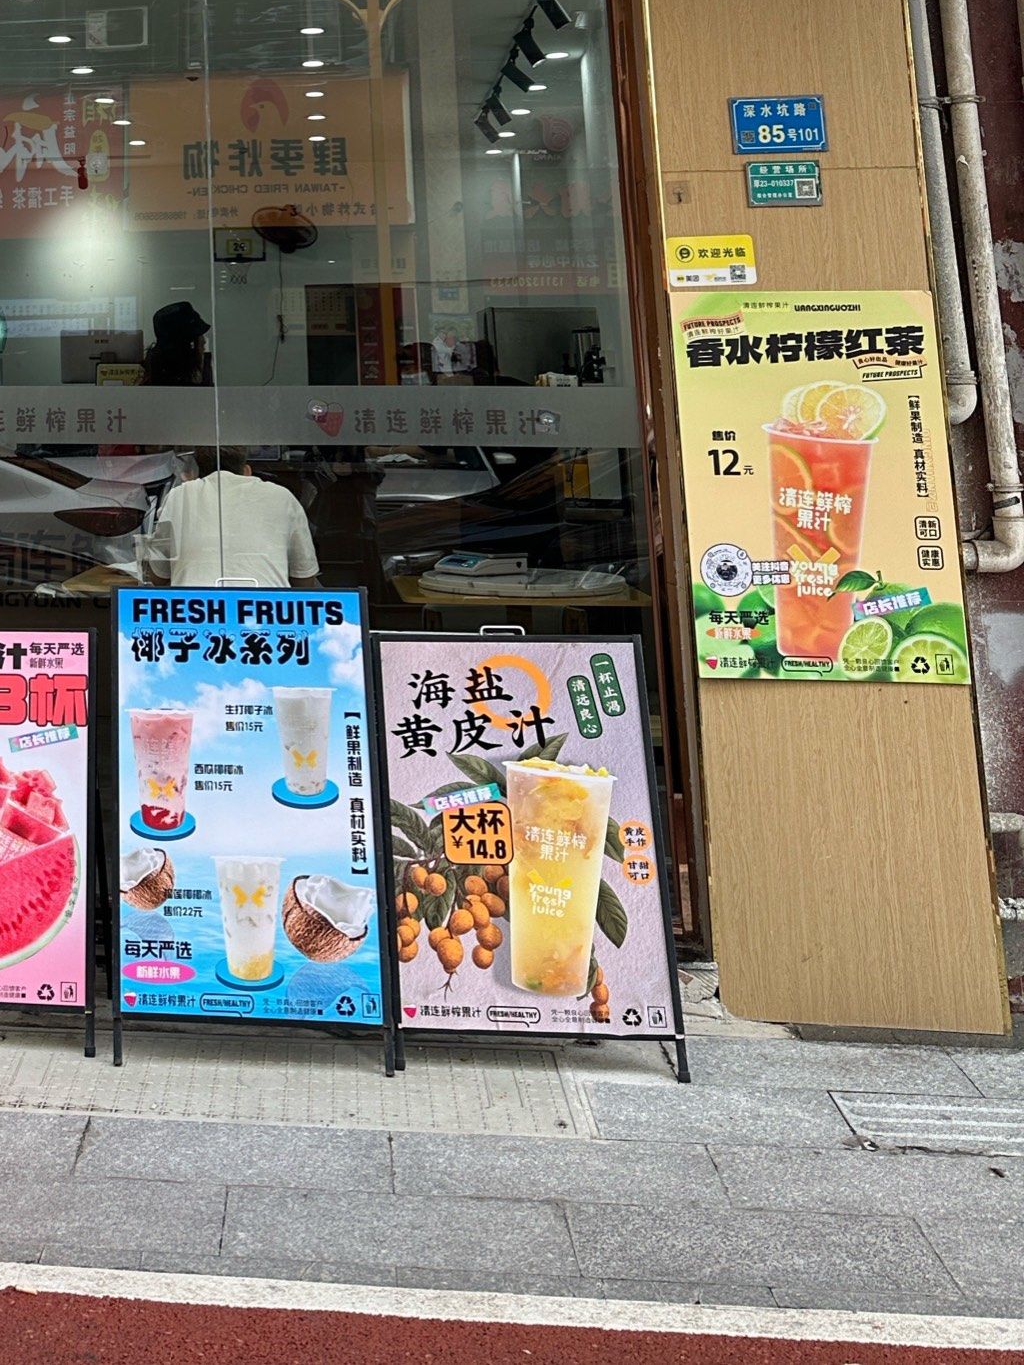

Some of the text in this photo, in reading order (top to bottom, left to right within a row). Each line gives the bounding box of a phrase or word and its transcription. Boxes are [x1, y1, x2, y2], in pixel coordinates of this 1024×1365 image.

[743, 102, 807, 117] 深水坑路
[757, 124, 820, 144] 85号101
[759, 165, 807, 175] 经营场所
[698, 246, 746, 259] 欢迎光临
[683, 316, 742, 331] FUTURE PROSPECTS
[686, 325, 925, 369] 香水柠檬红茶
[885, 369, 919, 378] PROSPECTS
[354, 406, 543, 435] 清连鲜榨果汁
[711, 430, 736, 442] 售价
[708, 449, 755, 477] 12元
[779, 487, 853, 515] 清连鲜榨
[797, 508, 832, 532] 果汁
[790, 560, 838, 576] young
[795, 569, 834, 585] fresh
[133, 598, 226, 625] FRESH
[237, 599, 344, 626] FRUITS
[862, 591, 924, 617] 店长推荐
[709, 609, 770, 626] 每天严选
[29, 641, 85, 656] 每天严选
[131, 629, 311, 666] 椰子冰系列
[29, 657, 64, 669] 新鲜水果
[410, 666, 514, 710] 海盐
[594, 660, 621, 714] 一杯止渴
[225, 704, 273, 716] 生打椰子冰
[572, 679, 598, 735] 清远良心
[225, 721, 264, 733] 售价15元
[392, 709, 556, 759] 黄皮汁
[18, 728, 72, 750] 店长推荐
[194, 763, 244, 776] 西瓜椰椰冰
[194, 780, 233, 792] 售价15元
[434, 786, 492, 812] 店长推荐
[449, 808, 505, 835] 大杯
[525, 825, 588, 850] 清连鲜榨
[624, 826, 646, 837] 黄皮
[625, 837, 647, 848] 手作
[539, 844, 569, 863] 果汁
[627, 860, 650, 871] 甘甜
[627, 871, 650, 882] 可口
[529, 882, 572, 901] young
[530, 891, 567, 908] fresh
[163, 905, 203, 918] 售价22元
[532, 904, 566, 918] juice
[125, 939, 193, 960] 每天严选
[136, 965, 181, 979] 新鲜水果
